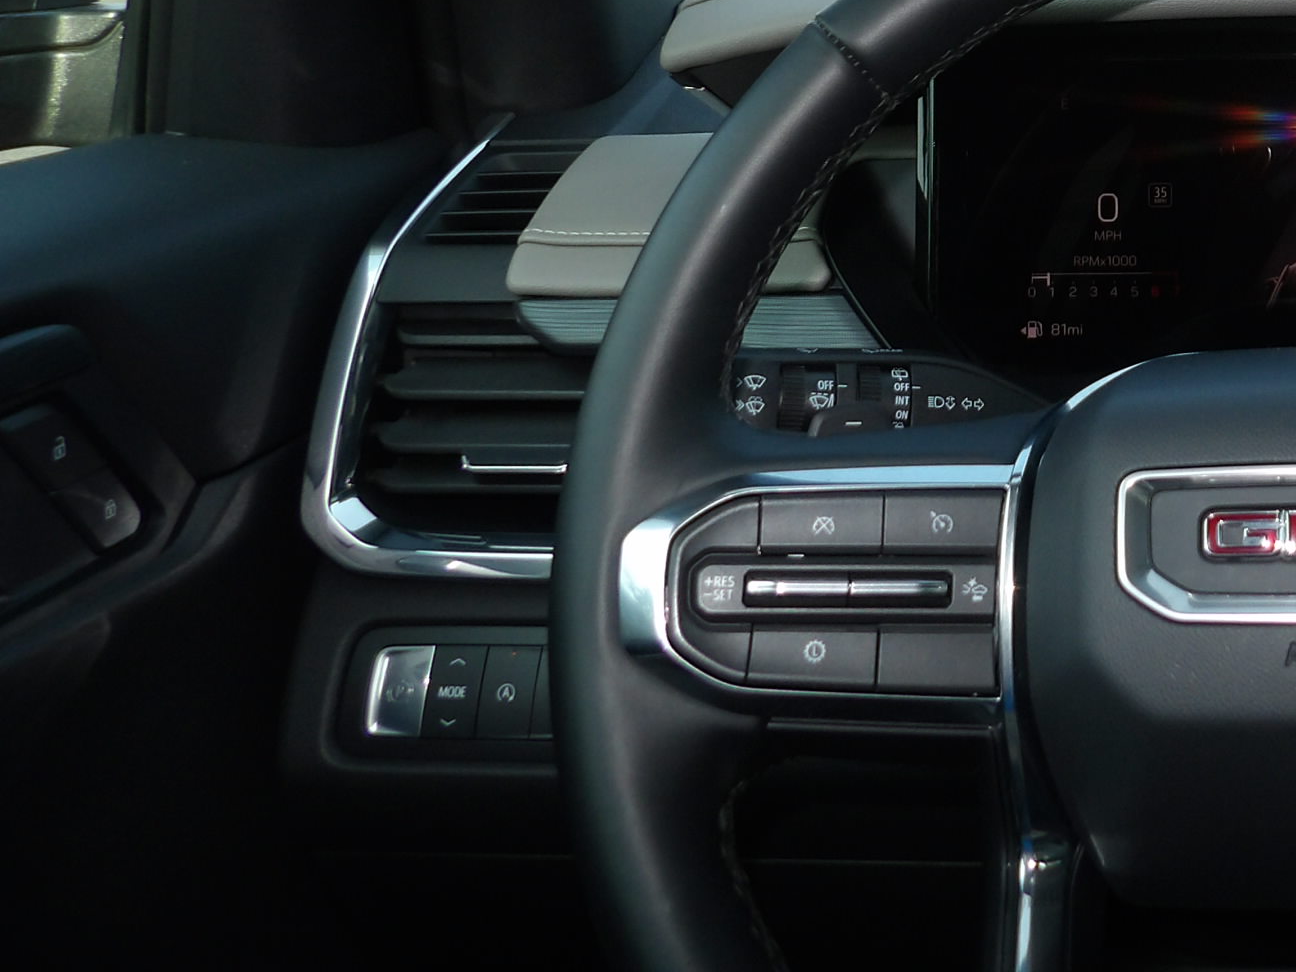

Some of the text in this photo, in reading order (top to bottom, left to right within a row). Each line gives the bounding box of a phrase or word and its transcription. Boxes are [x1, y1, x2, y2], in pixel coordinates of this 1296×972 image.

[1153, 186, 1168, 198] 35
[1097, 192, 1119, 223] 0
[1094, 230, 1122, 241] MPH
[1073, 255, 1137, 267] RPMx1000
[1027, 286, 1037, 298] 0
[1068, 286, 1079, 298] 2
[1089, 286, 1099, 298] 3
[1110, 286, 1119, 298] 4
[1131, 286, 1140, 298] 5
[1051, 323, 1084, 337] 81mi
[817, 379, 835, 392] OFF
[893, 382, 911, 393] OFF
[894, 395, 911, 406] INT
[895, 410, 909, 421] ON
[437, 685, 468, 699] MODE
